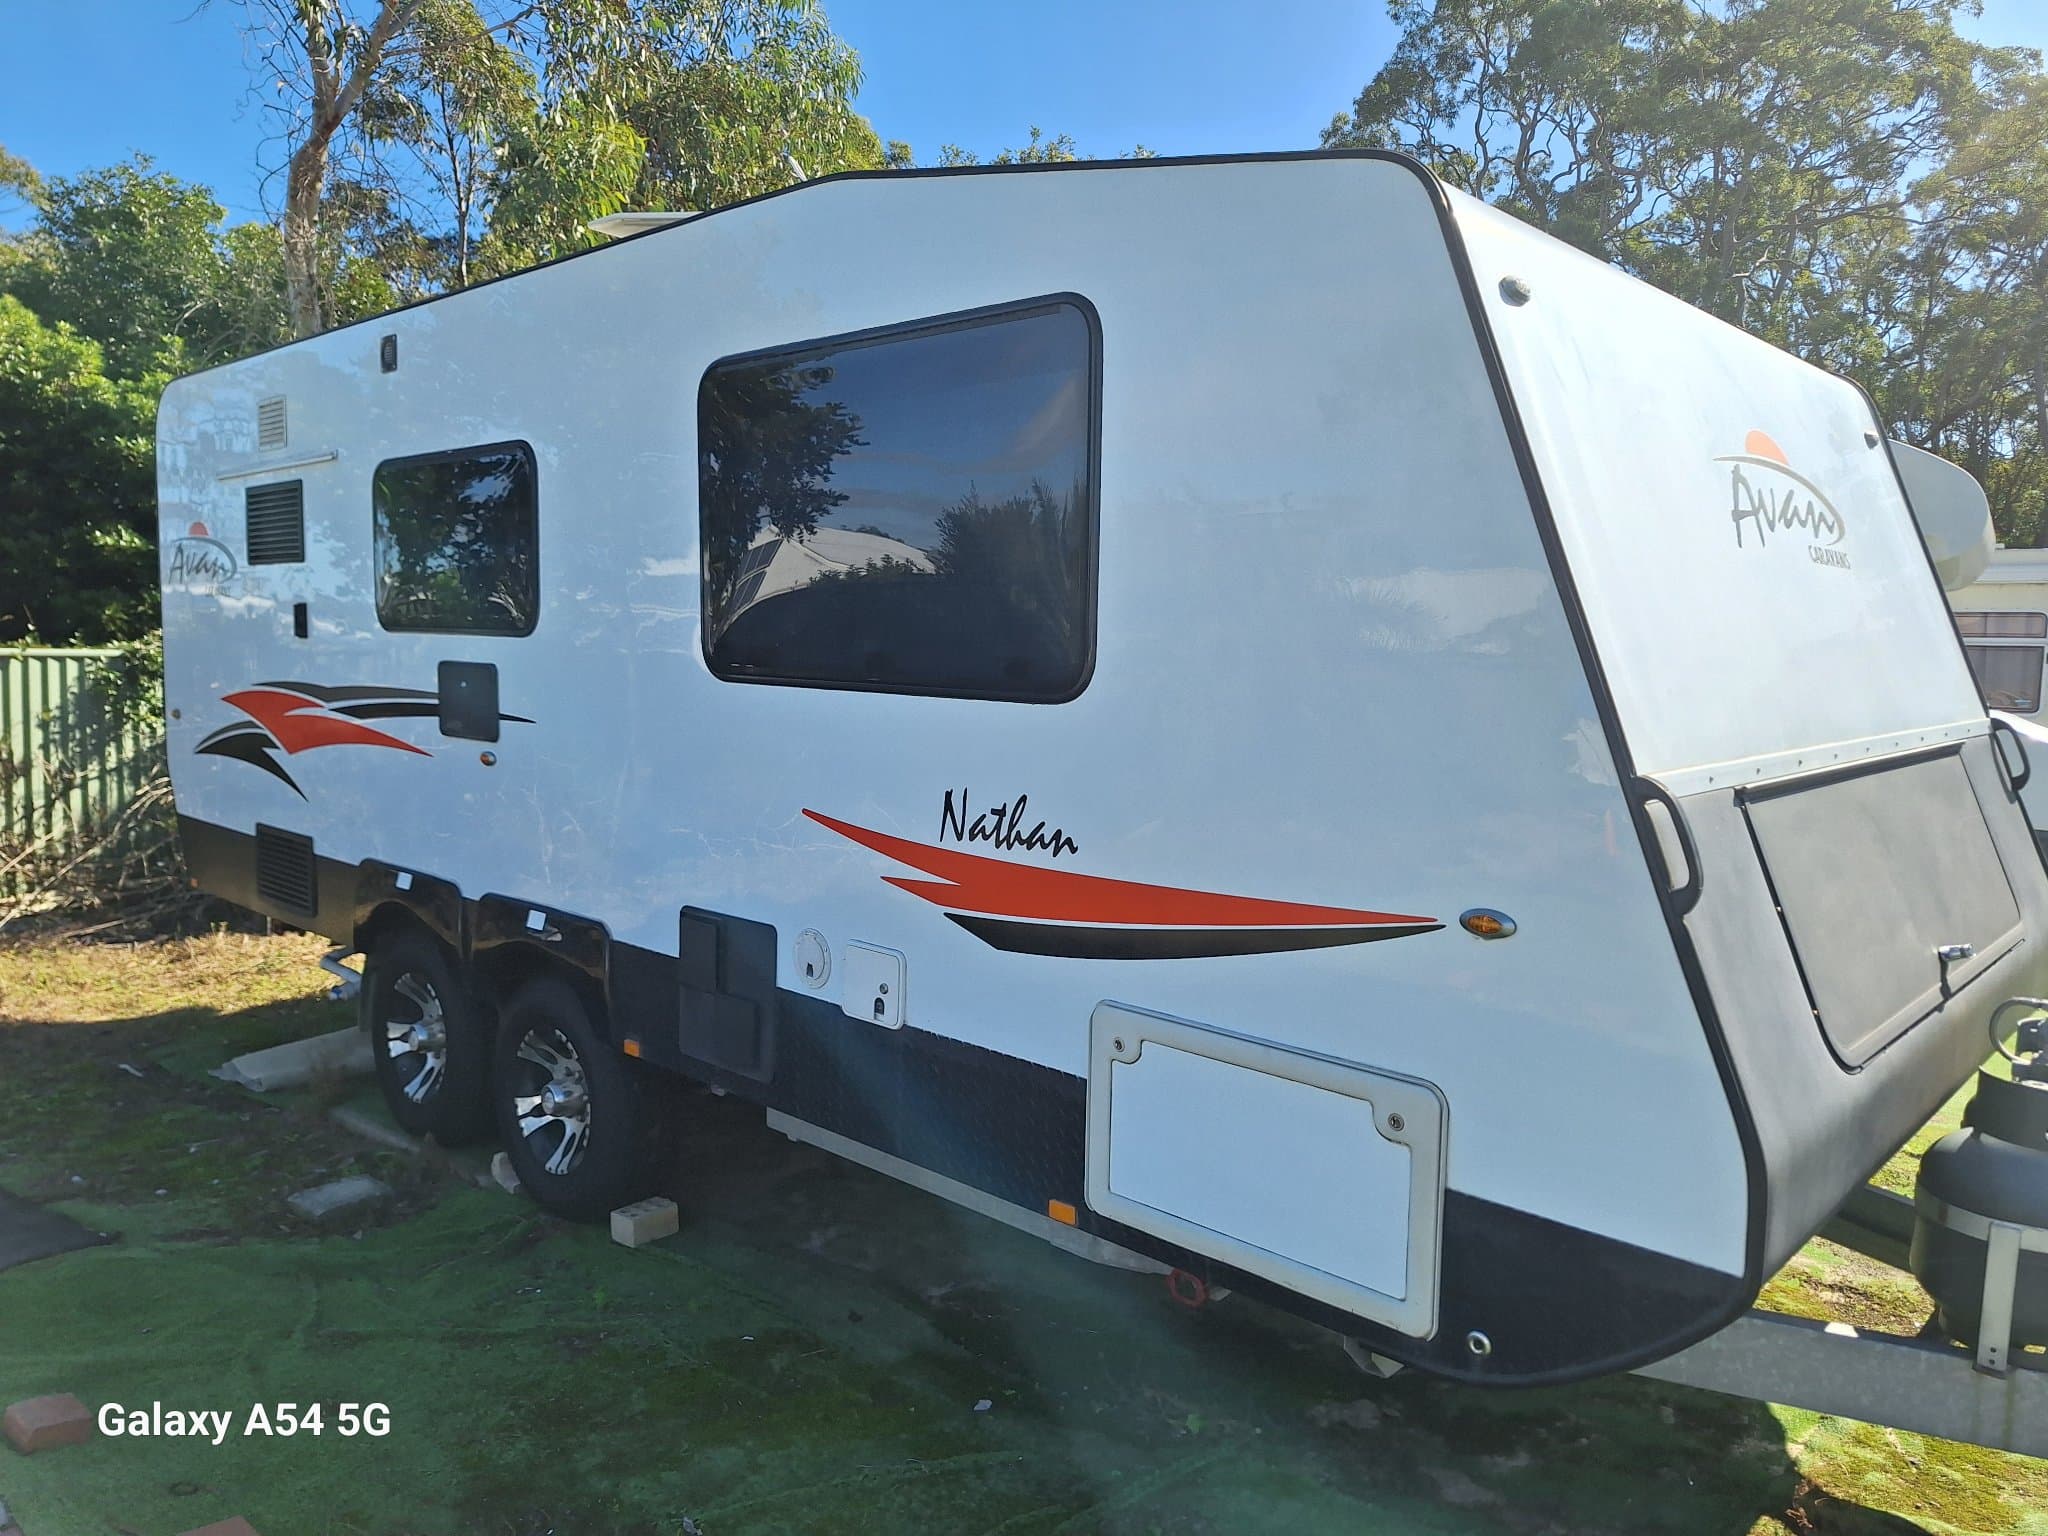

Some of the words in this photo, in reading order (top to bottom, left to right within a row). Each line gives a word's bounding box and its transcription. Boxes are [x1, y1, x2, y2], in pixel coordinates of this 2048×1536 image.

[1731, 464, 1836, 548] Avan
[1808, 545, 1851, 569] CARAVANS
[940, 787, 1079, 858] Nathan
